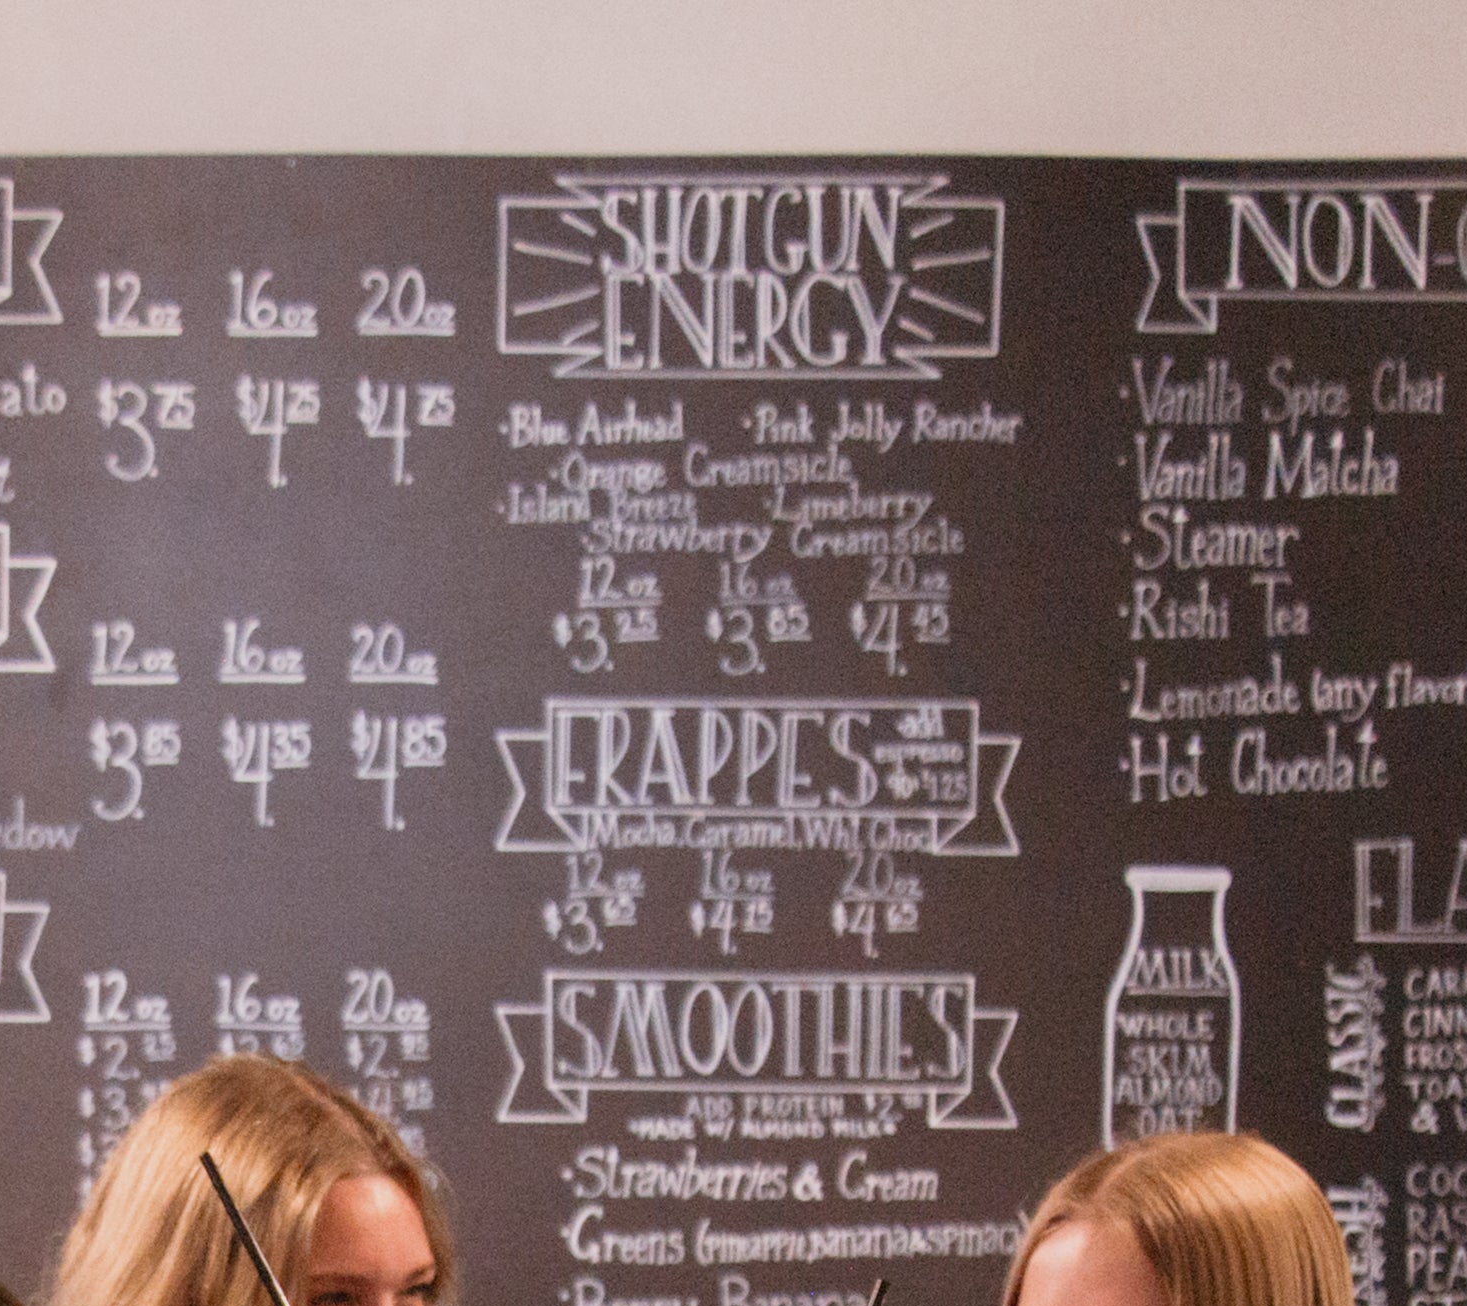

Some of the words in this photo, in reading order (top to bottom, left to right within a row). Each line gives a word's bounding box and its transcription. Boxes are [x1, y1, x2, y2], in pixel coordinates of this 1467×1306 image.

[603, 188, 901, 275] SHOTGUN
[605, 271, 906, 369] ENERGY
[1132, 355, 1243, 426] Vanilla
[1372, 356, 1446, 415] Chai
[510, 405, 569, 447] Blue
[577, 403, 684, 444] Airhead
[756, 404, 814, 443] Pink
[831, 404, 903, 452] Jolly
[913, 402, 1023, 443] Rancher
[561, 451, 666, 491] Orange
[1135, 431, 1246, 500] Vanilla
[1265, 426, 1400, 500] Matcha
[509, 484, 591, 523] Island
[585, 517, 774, 563] Strawberry
[1133, 504, 1301, 570] Steamer
[1130, 578, 1230, 640] Rishi
[1250, 572, 1310, 638] Tea
[1129, 652, 1302, 722] Lemonade
[556, 709, 877, 807] FRAPPES
[1130, 732, 1208, 802] Hot
[1231, 720, 1389, 796] Chocolate
[1127, 947, 1228, 989] MILK
[558, 981, 966, 1080] SMOOTHIES
[1116, 1010, 1214, 1041] WHOLE
[744, 1095, 845, 1118] PROTEIN
[1115, 1075, 1224, 1106] ALMOND
[1410, 1104, 1439, 1135] &
[575, 1145, 788, 1200] Strawberries
[793, 1163, 824, 1201] &
[839, 1150, 940, 1201] Cream
[568, 1205, 686, 1264] Greens
